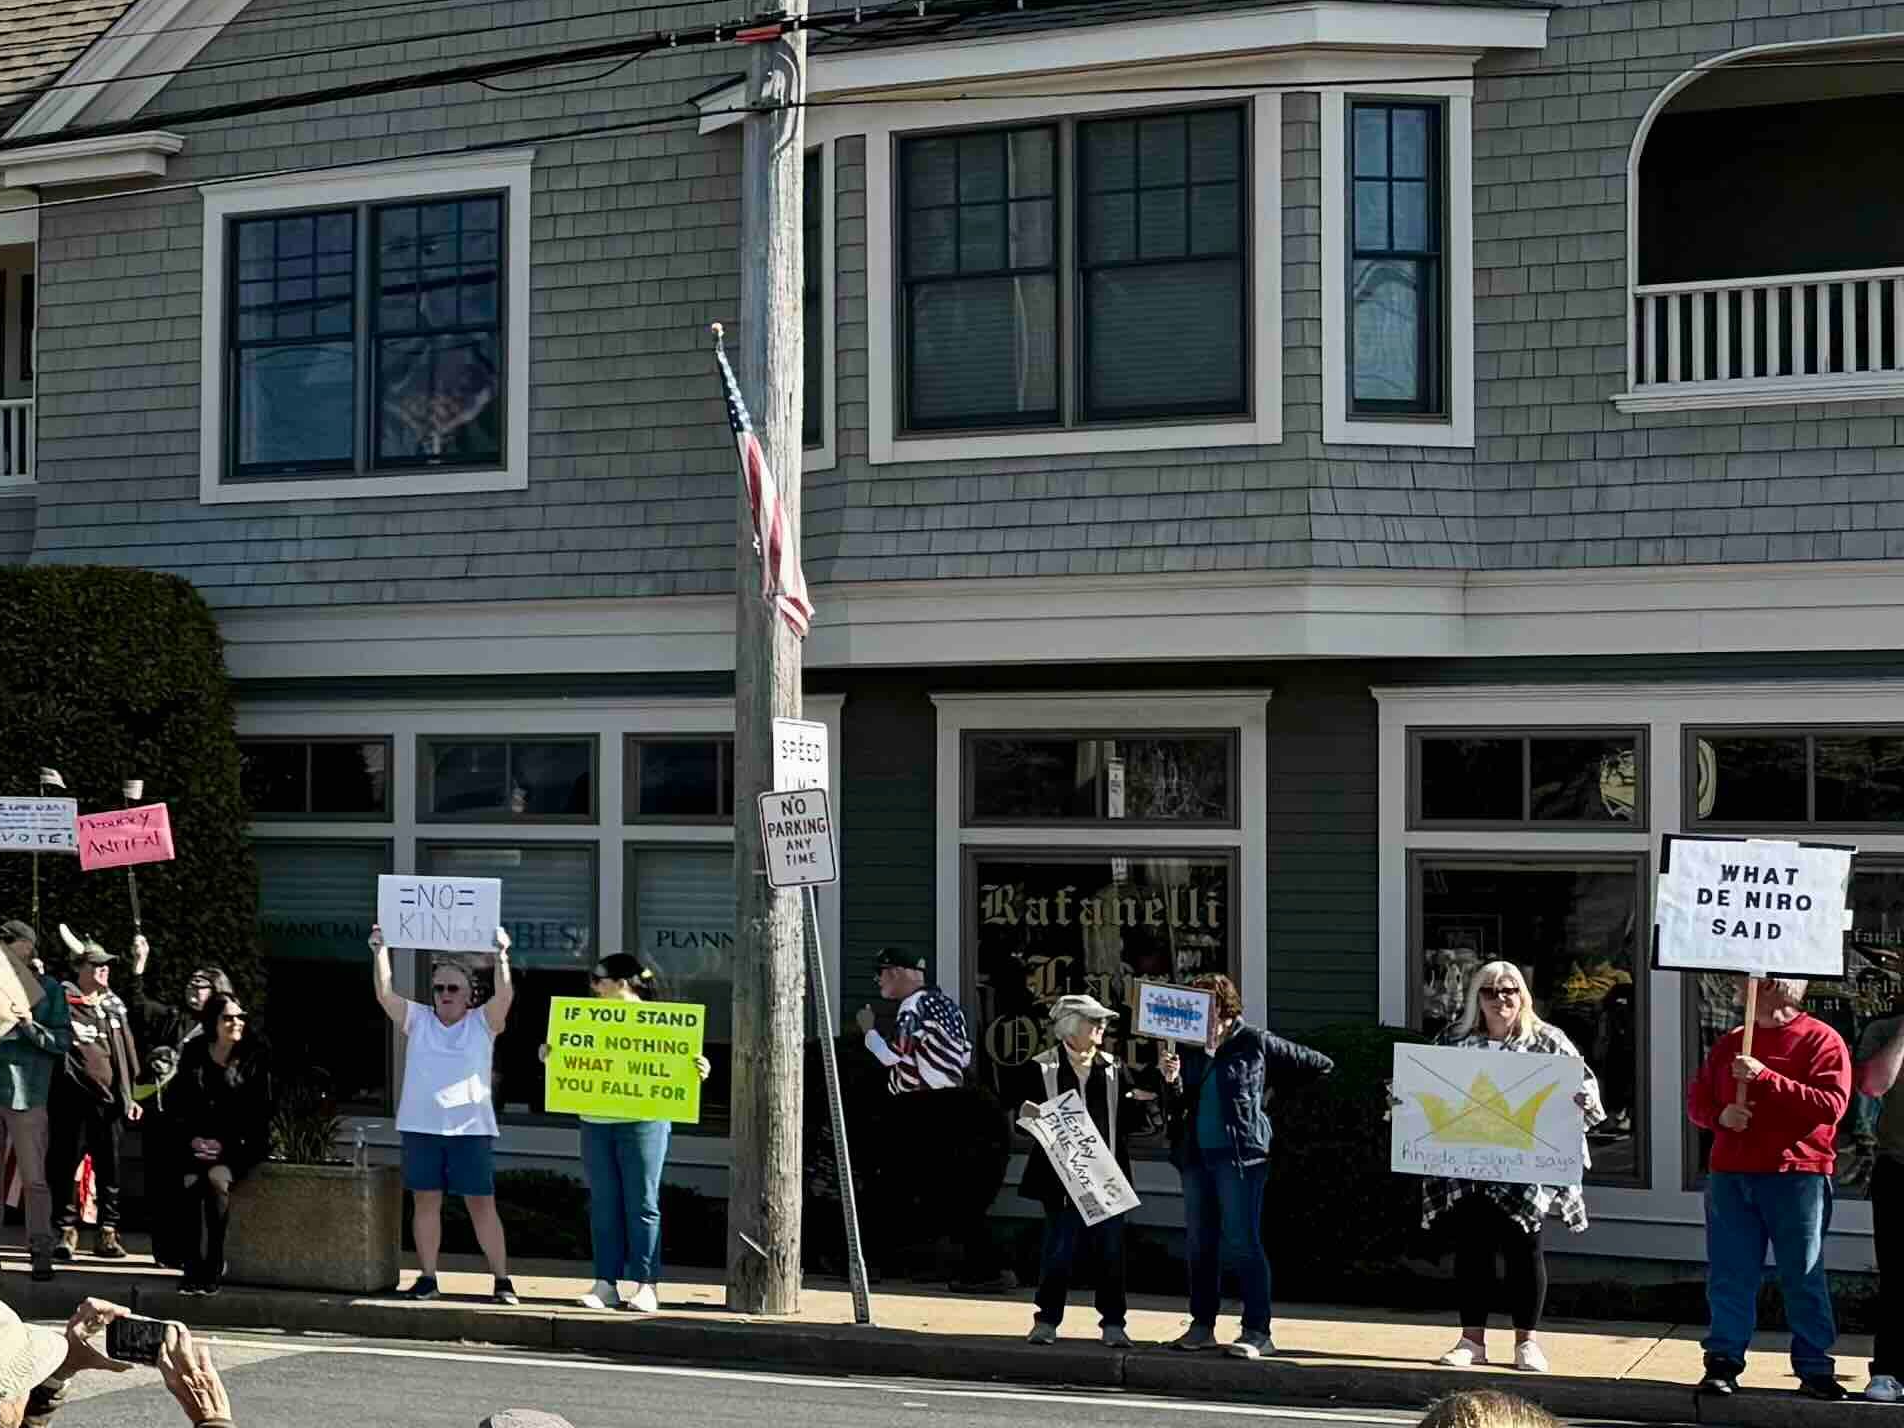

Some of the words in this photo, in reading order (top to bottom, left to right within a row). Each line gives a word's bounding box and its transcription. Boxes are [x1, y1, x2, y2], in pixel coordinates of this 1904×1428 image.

[781, 798, 807, 816] NO
[768, 818, 826, 838] PARKING
[786, 838, 812, 851] ANY
[785, 852, 817, 867] TIME
[1720, 864, 1799, 886] WHAT
[980, 883, 1225, 928] Rafanelli
[1697, 888, 1731, 907] DE
[1745, 891, 1813, 912] NIRO
[1711, 918, 1782, 940] SAID
[565, 1007, 581, 1020] IF
[588, 1008, 626, 1023] YOU
[636, 1010, 698, 1028] STAND
[559, 1033, 594, 1048] FOR
[605, 1036, 689, 1056] NOTHING
[563, 1055, 614, 1073] WHAT
[627, 1061, 671, 1078] WILL
[555, 1076, 593, 1093] YOU
[601, 1080, 644, 1098] FALL
[650, 1085, 686, 1101] FOR
